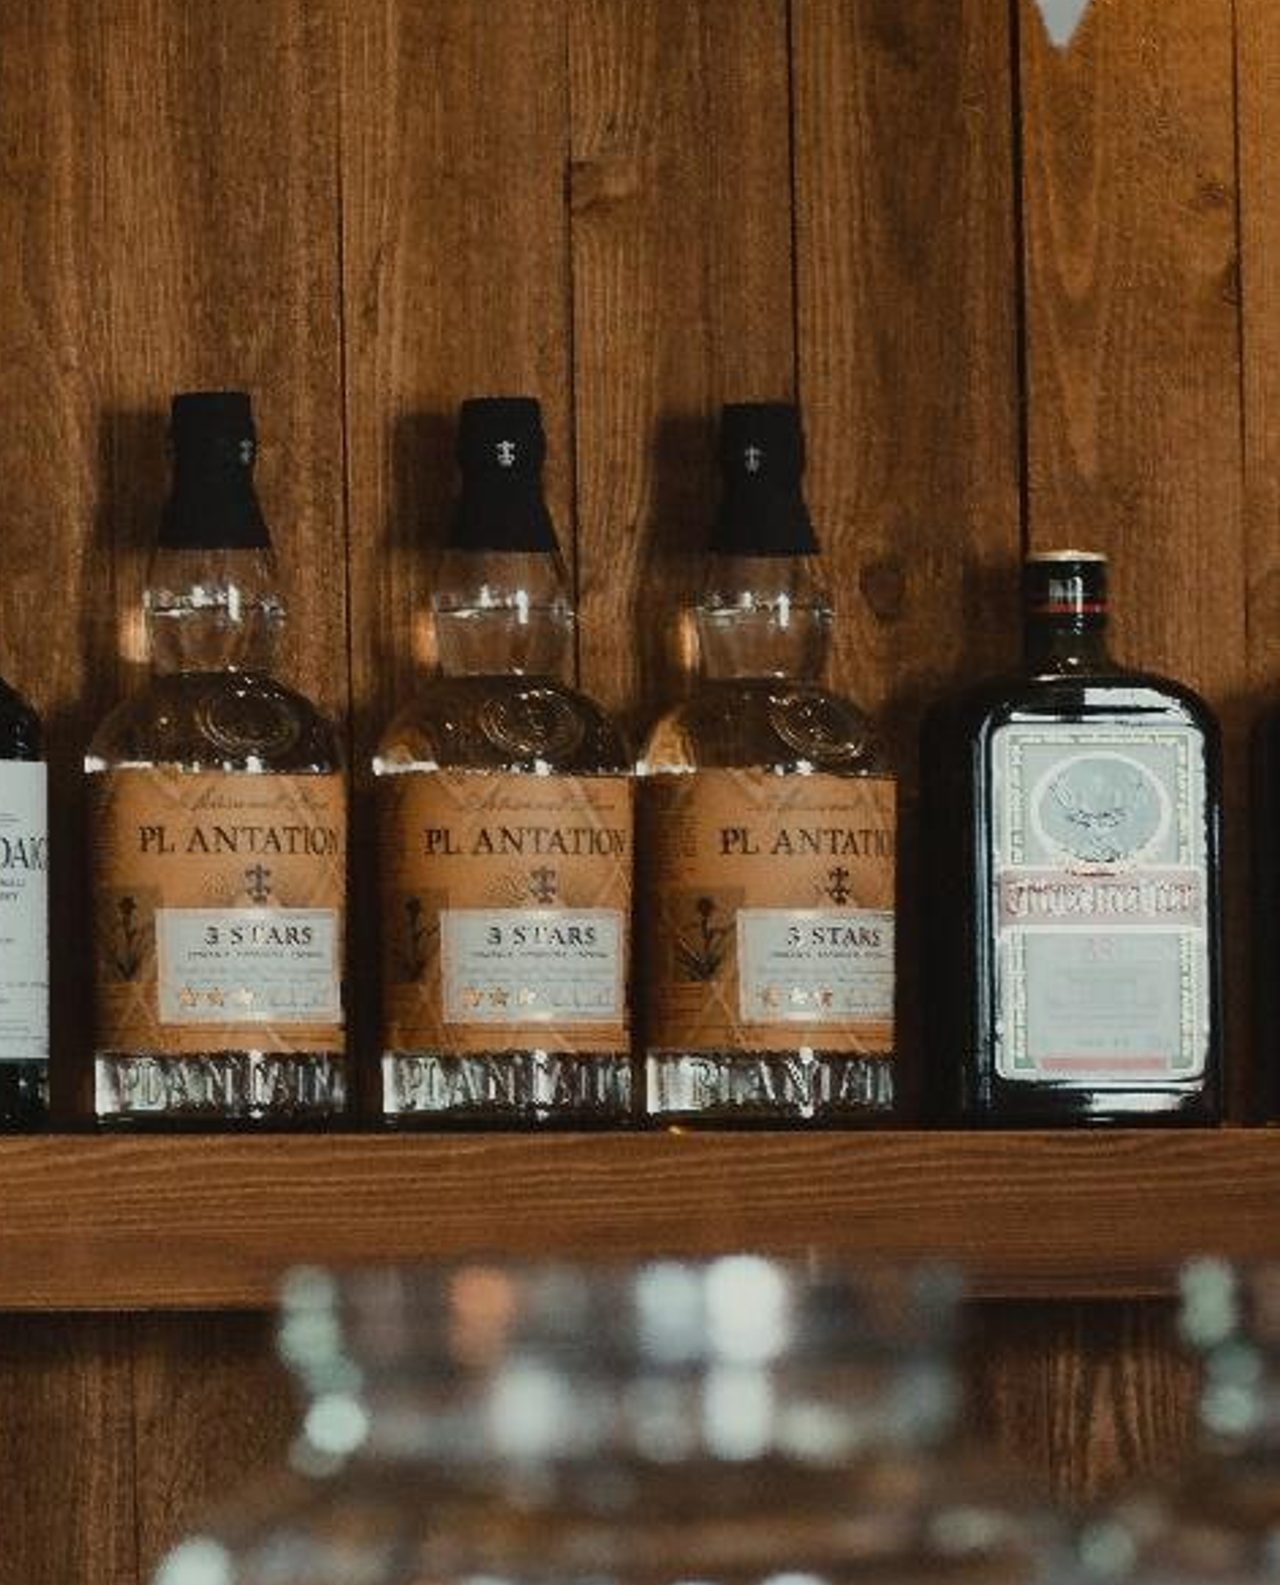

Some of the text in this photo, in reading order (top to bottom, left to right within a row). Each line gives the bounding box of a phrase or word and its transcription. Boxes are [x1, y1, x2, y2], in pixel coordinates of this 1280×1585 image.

[203, 924, 314, 947] 3 STARS
[485, 924, 598, 947] 3 STARS
[786, 924, 885, 949] 3 STARS
